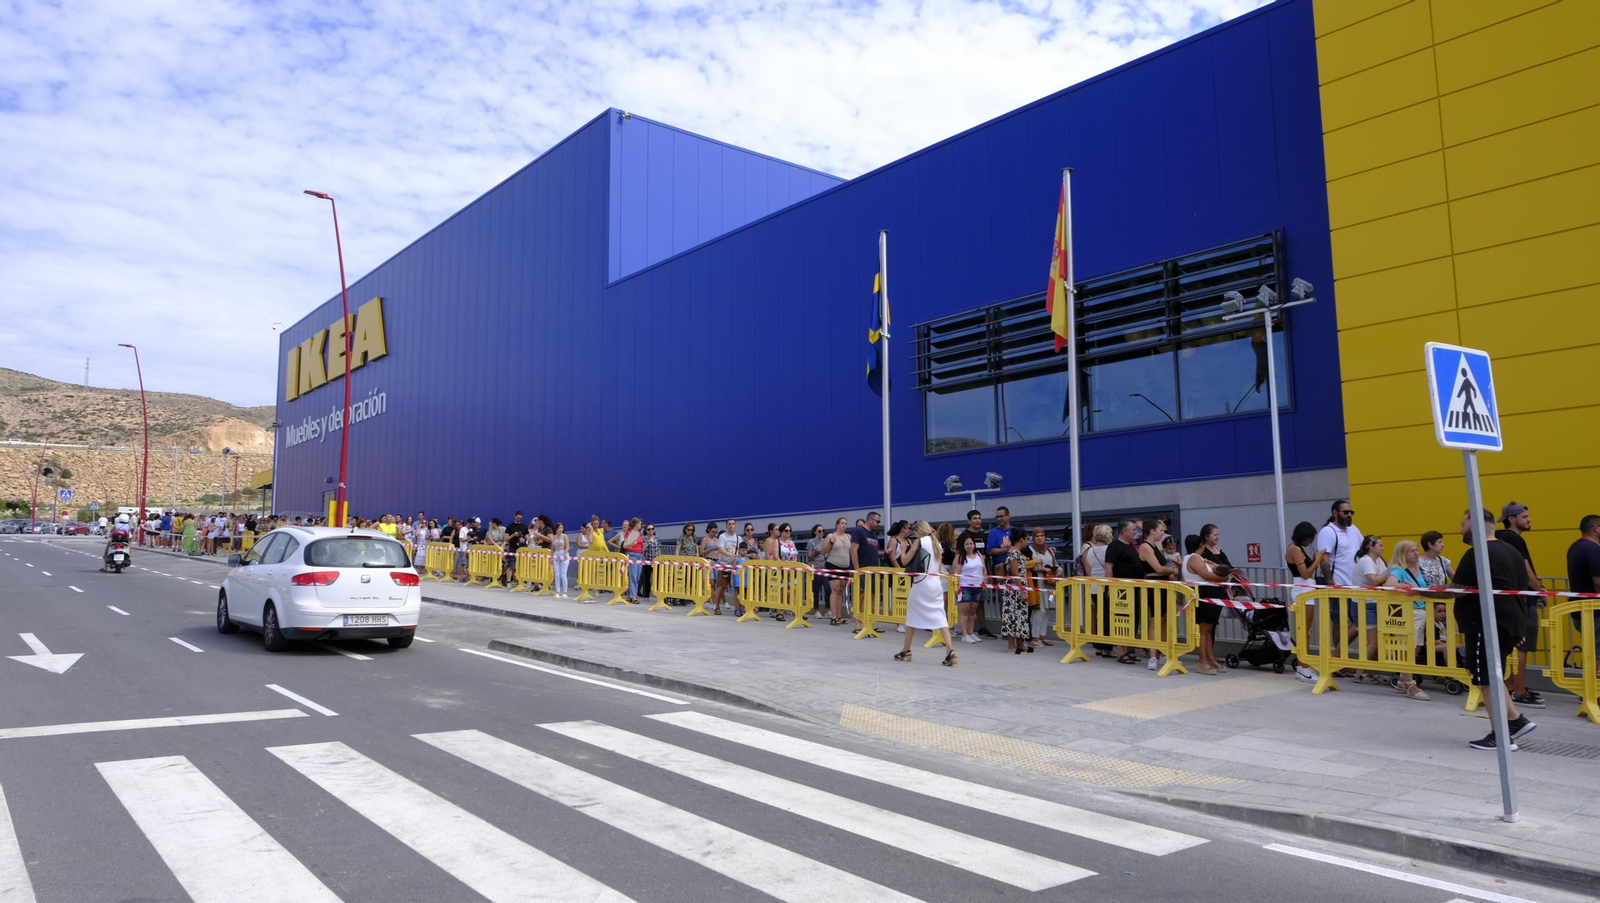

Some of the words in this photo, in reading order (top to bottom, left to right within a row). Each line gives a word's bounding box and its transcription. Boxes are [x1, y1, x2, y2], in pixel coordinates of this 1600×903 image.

[286, 296, 388, 402] IKEA
[286, 416, 320, 448] Muebles
[320, 416, 328, 443] y
[350, 615, 370, 623] 1208
[372, 615, 386, 623] HHS
